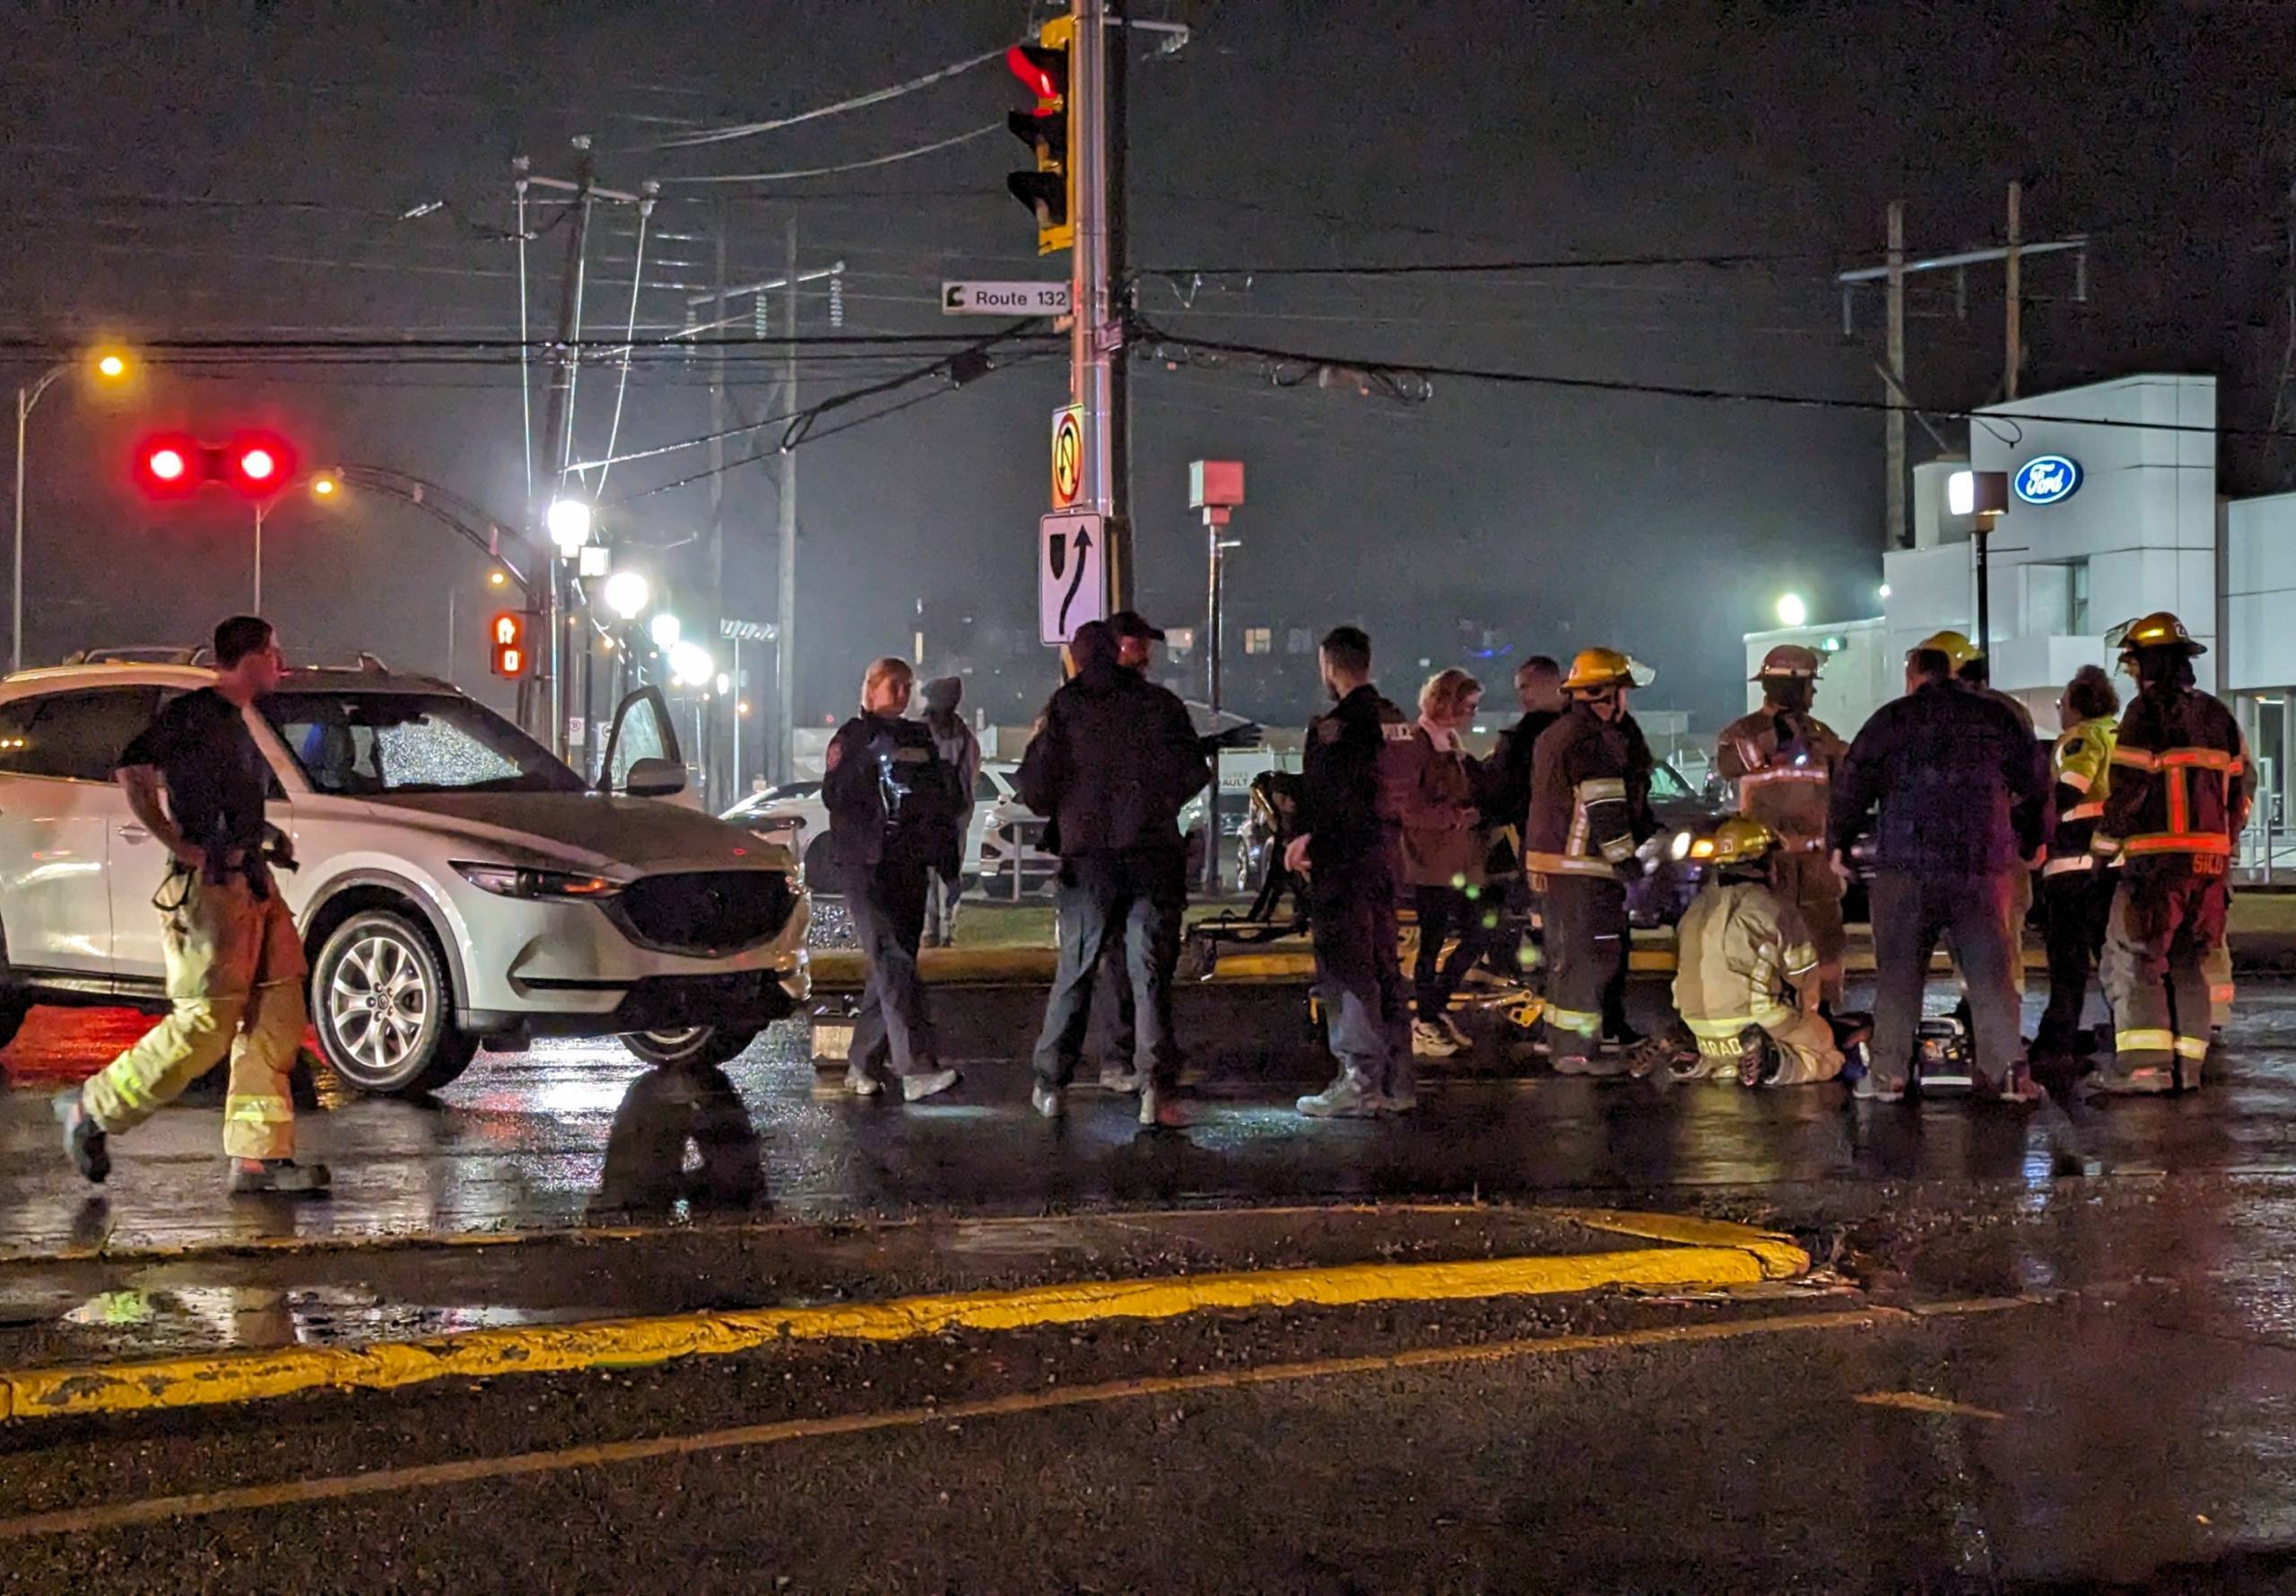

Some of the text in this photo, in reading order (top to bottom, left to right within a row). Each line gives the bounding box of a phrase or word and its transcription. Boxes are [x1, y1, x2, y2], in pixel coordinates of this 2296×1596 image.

[976, 291, 1067, 307] Route 132
[2025, 463, 2065, 496] Ford
[1220, 778, 1248, 786] AULT
